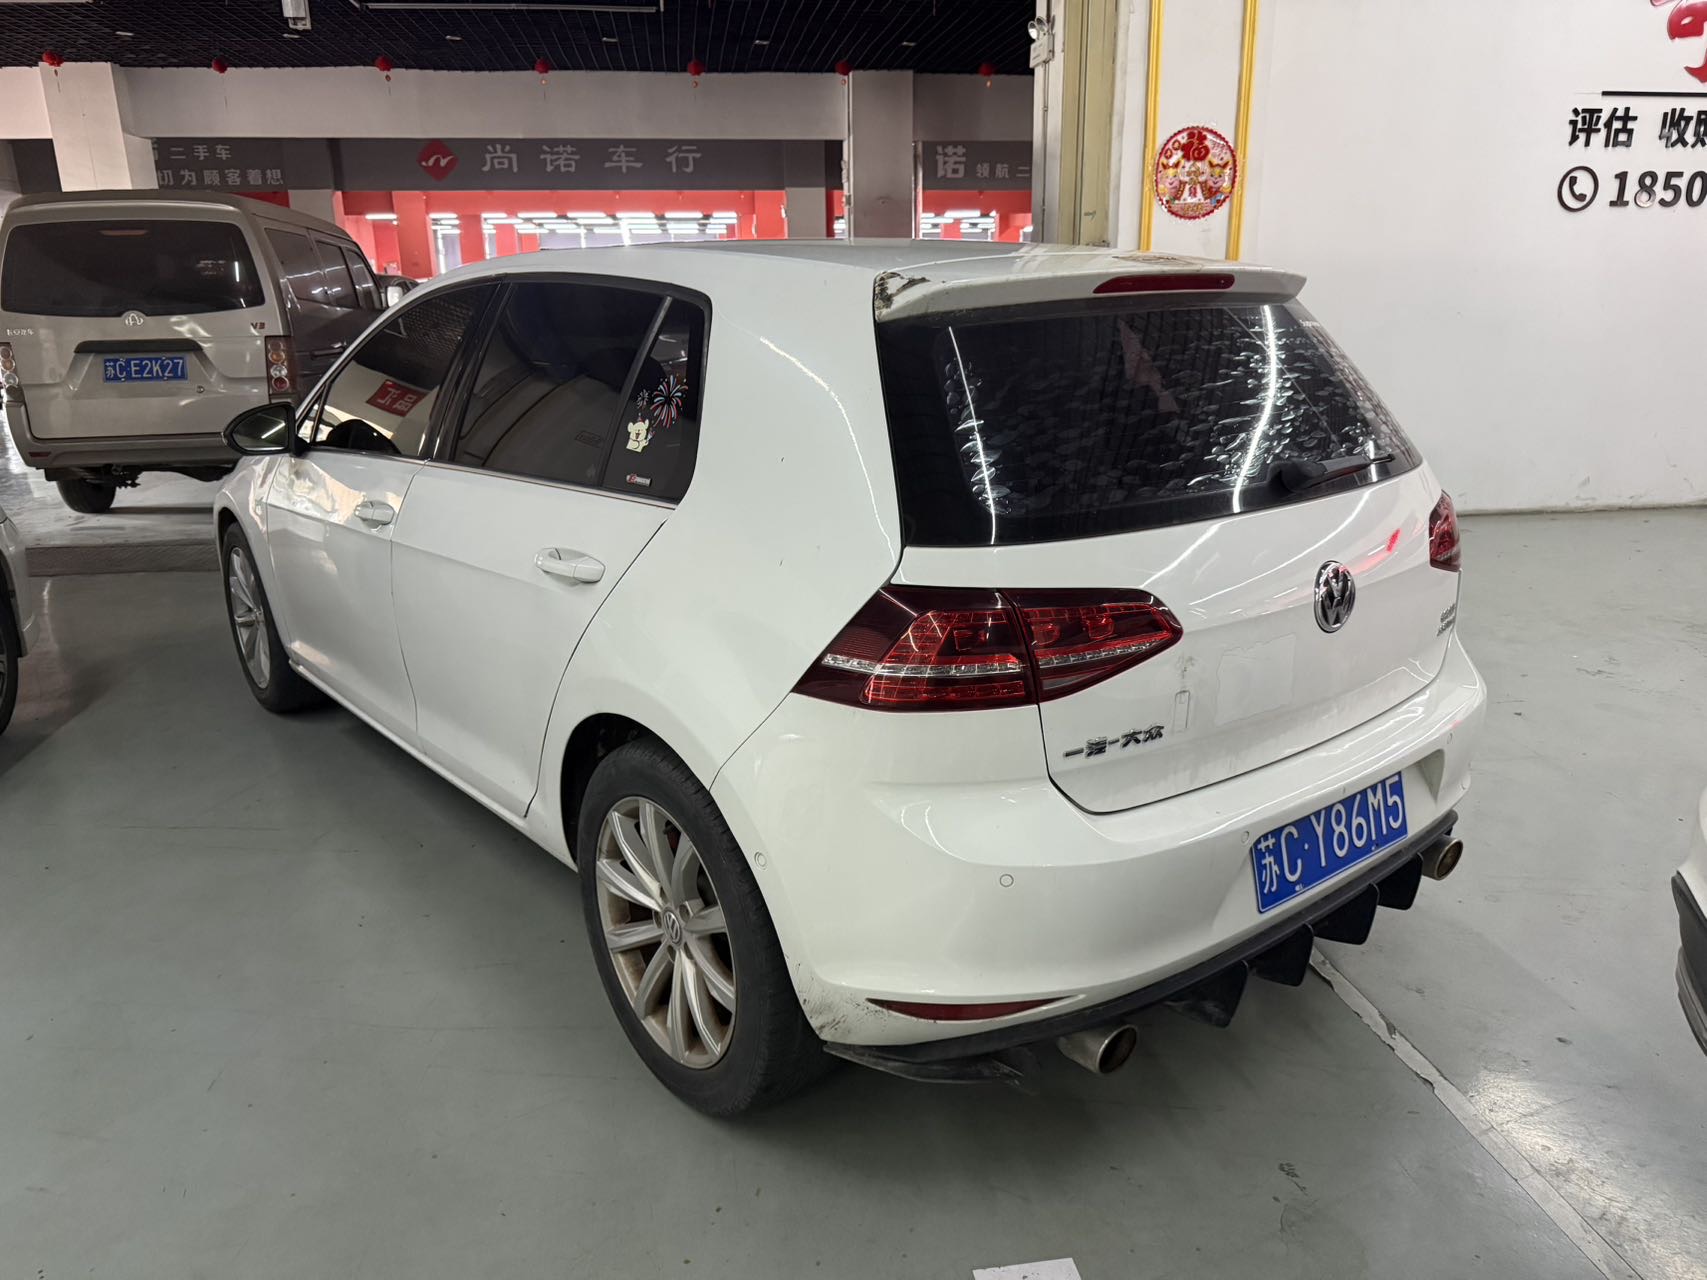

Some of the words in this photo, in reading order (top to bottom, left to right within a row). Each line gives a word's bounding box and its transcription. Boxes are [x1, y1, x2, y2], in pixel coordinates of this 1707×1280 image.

[1568, 107, 1638, 148] 评估
[170, 144, 232, 161] 二手车
[481, 143, 702, 174] 尚诺车行
[1609, 170, 1707, 208] 1850
